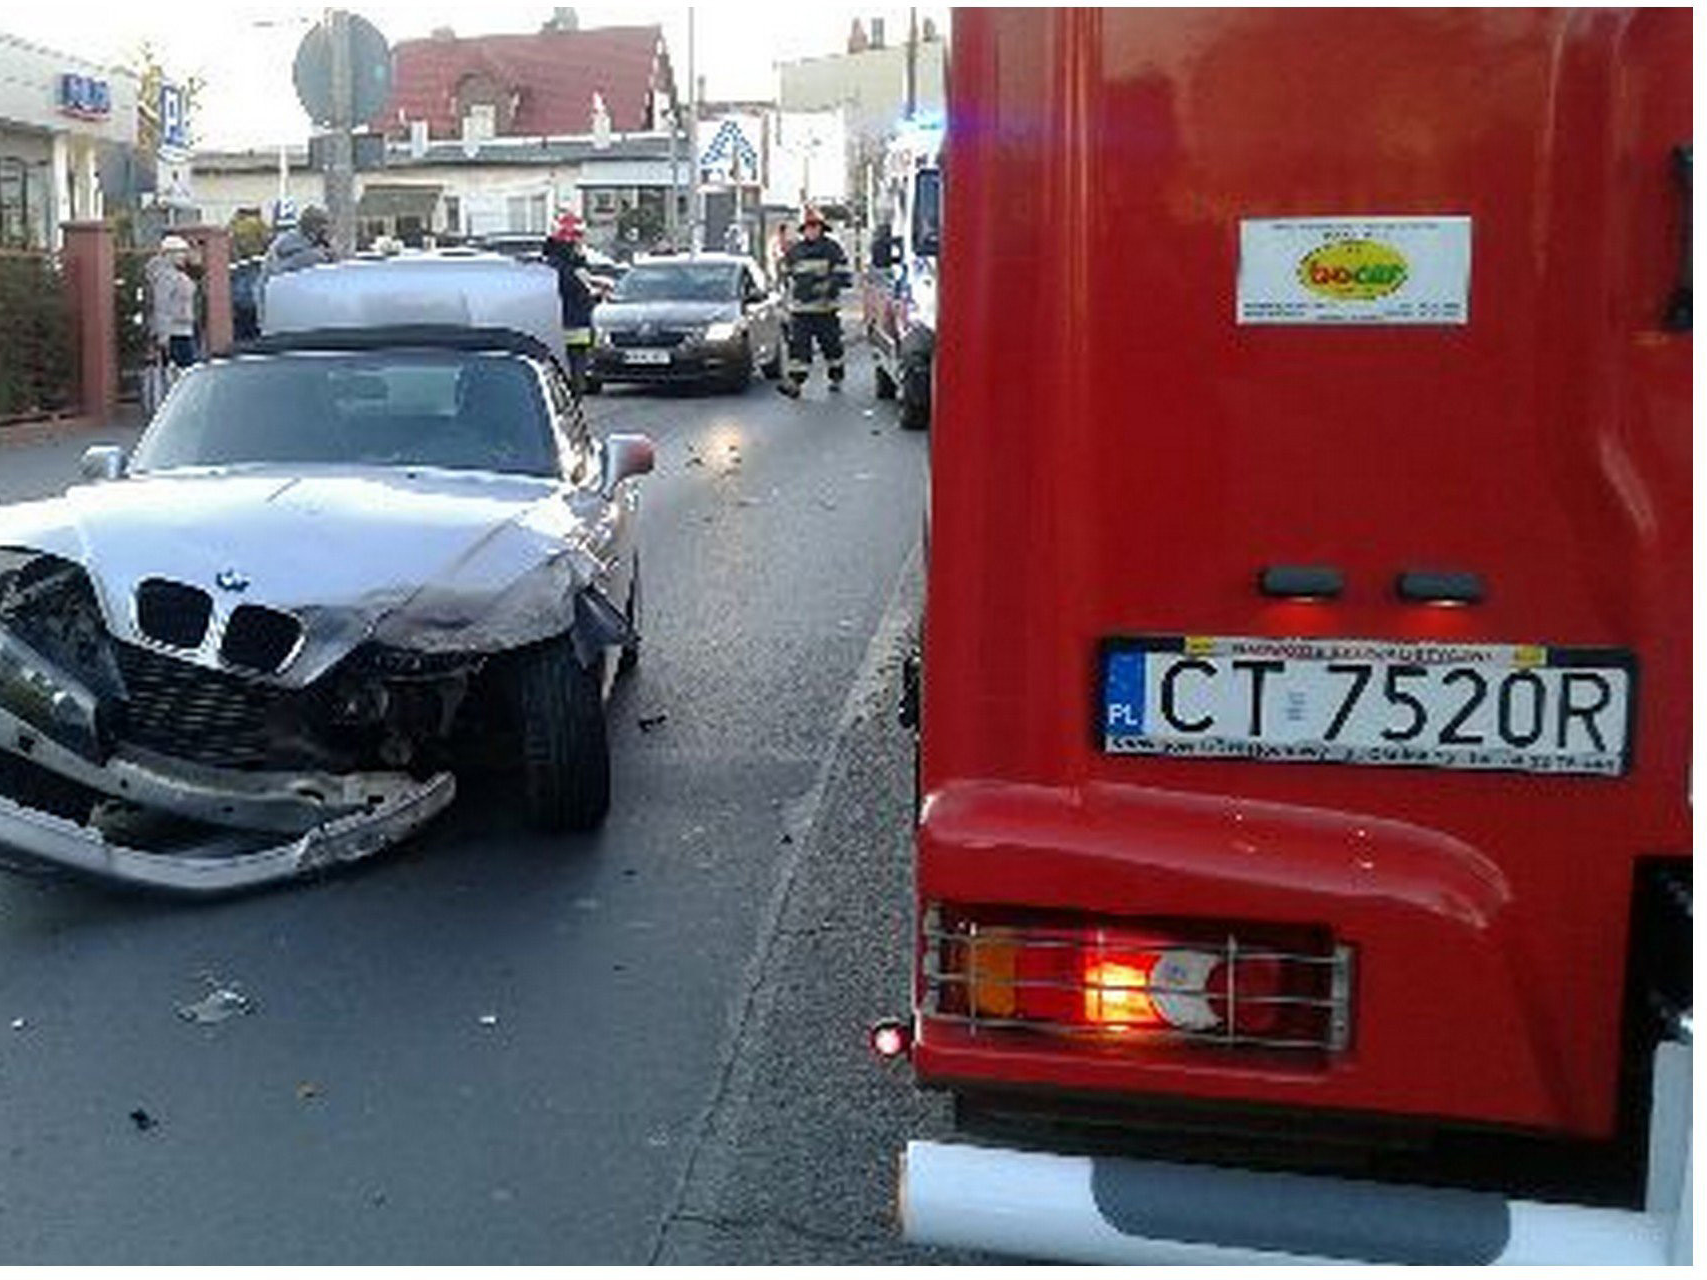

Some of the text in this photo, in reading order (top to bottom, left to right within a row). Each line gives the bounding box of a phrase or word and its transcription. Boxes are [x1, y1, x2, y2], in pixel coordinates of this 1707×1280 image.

[1108, 703, 1137, 725] PL
[1160, 659, 1285, 737] CT
[1322, 664, 1612, 753] 7520R
